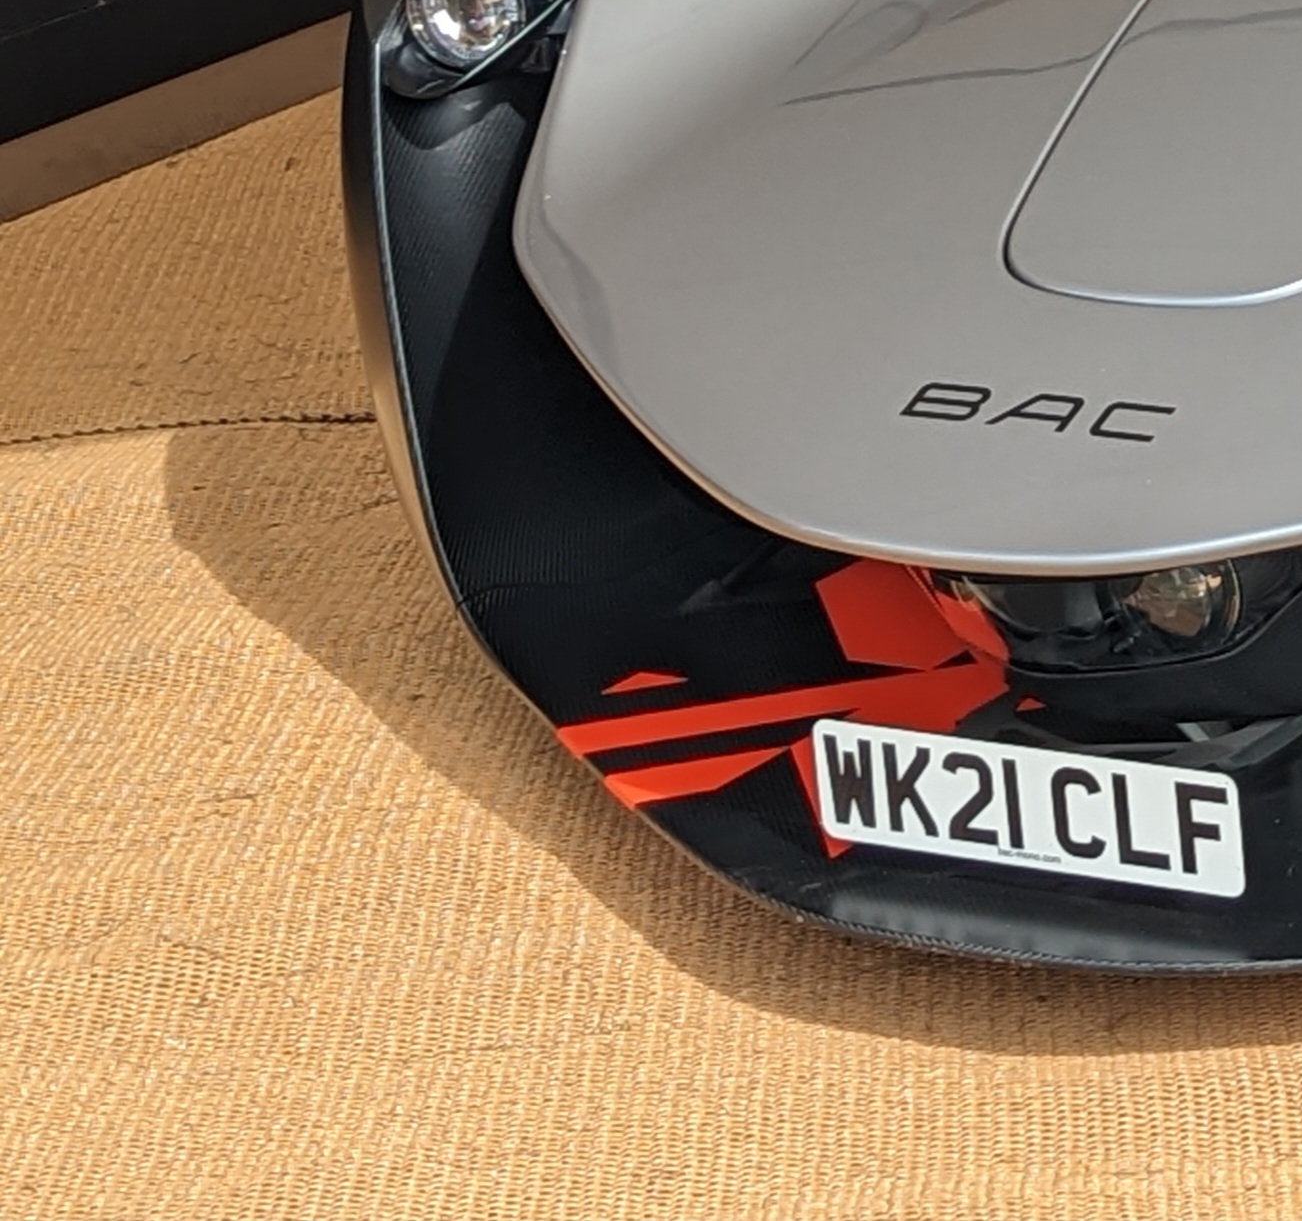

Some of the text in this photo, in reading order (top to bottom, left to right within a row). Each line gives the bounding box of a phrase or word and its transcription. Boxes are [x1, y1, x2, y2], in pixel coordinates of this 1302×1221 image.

[899, 382, 1176, 442] BAC
[822, 734, 1228, 875] WK21 CLF
